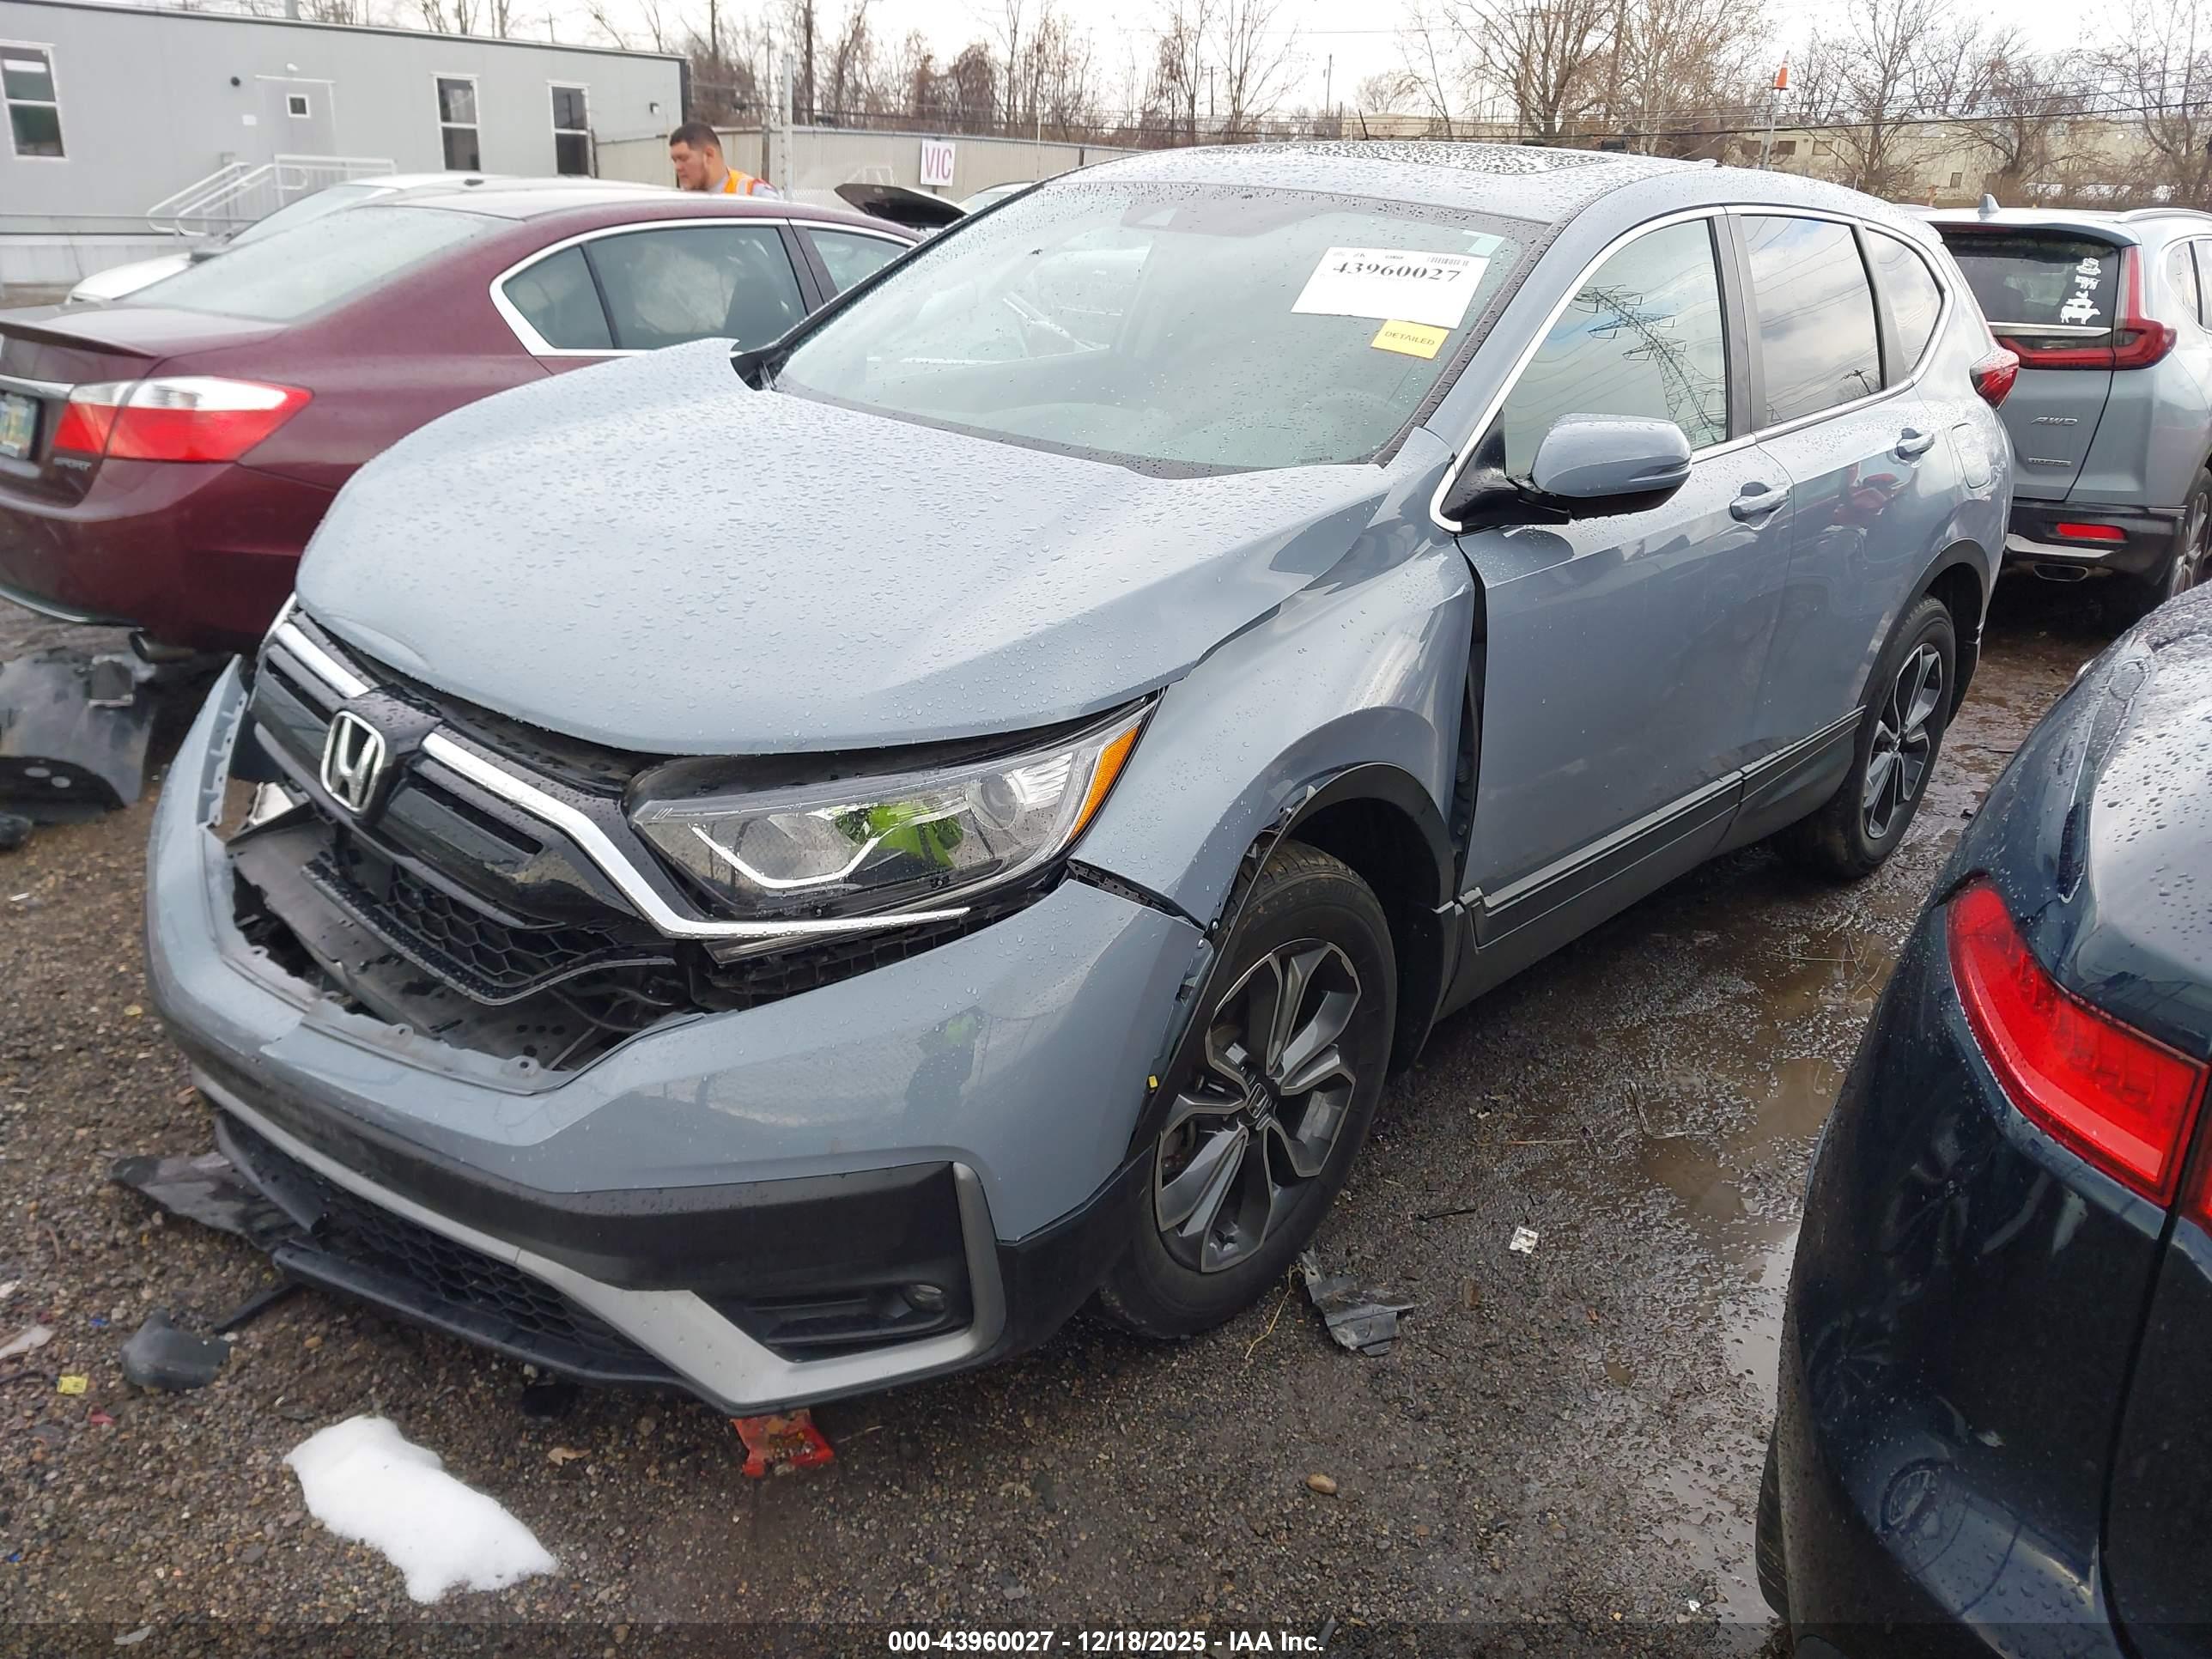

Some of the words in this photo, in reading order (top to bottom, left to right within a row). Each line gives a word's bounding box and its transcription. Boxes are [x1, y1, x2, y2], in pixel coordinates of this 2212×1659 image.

[925, 146, 952, 180] VIC
[1333, 261, 1462, 282] 43960027
[1384, 331, 1435, 345] DETAILED
[2030, 416, 2078, 426] AWD
